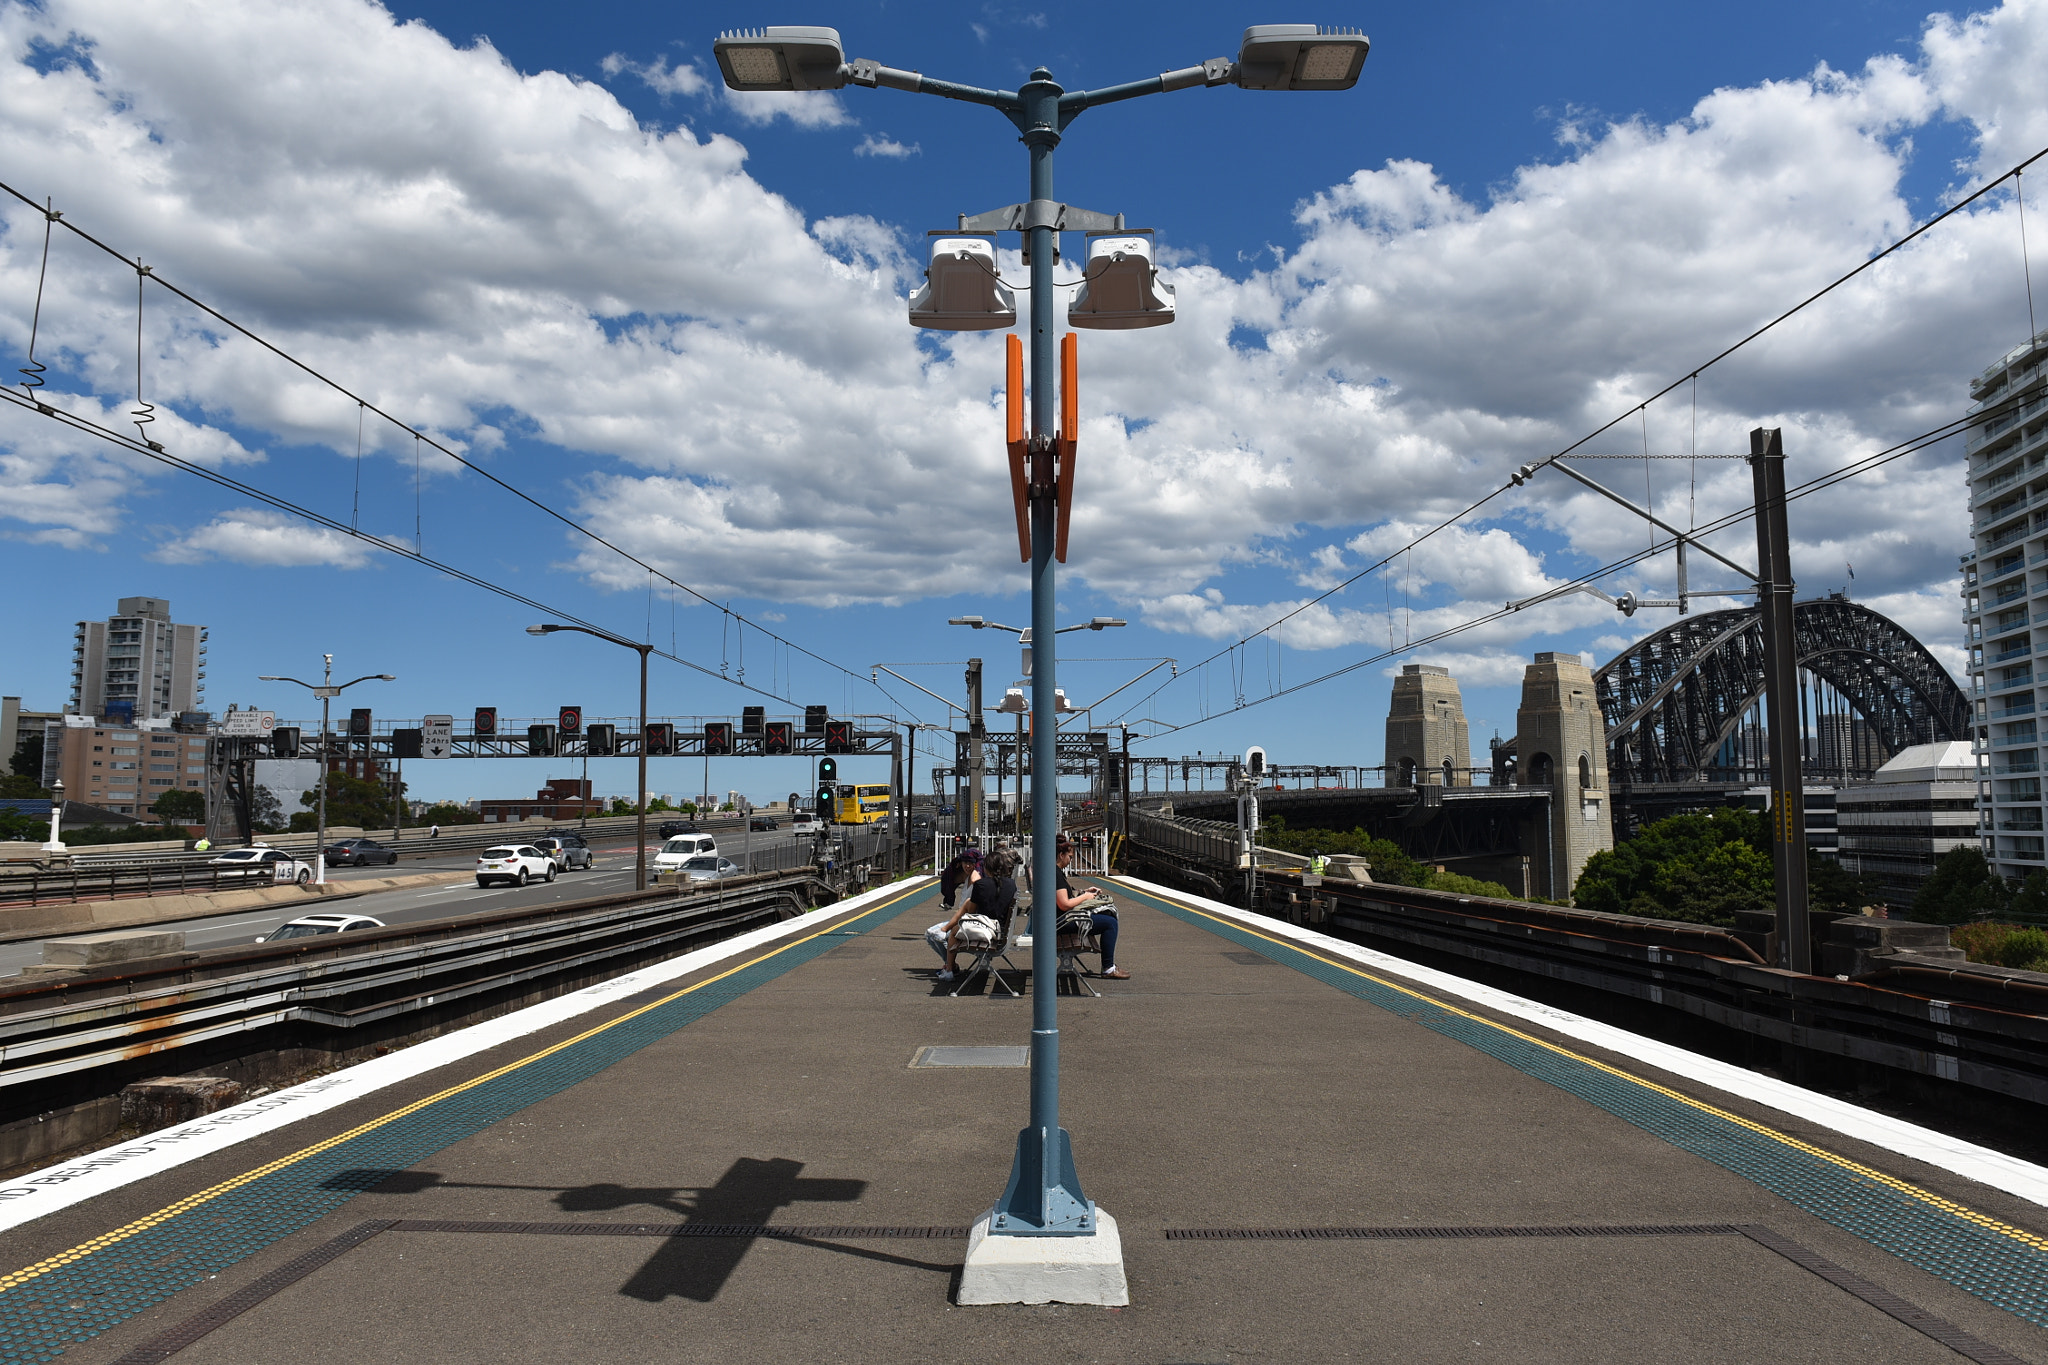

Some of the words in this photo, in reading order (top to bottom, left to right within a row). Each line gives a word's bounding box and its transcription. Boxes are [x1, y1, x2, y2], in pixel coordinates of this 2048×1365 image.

[425, 737, 450, 745] 24hrs
[656, 747, 663, 755] 4
[715, 747, 722, 755] 3
[776, 746, 782, 754] 2
[24, 1147, 157, 1185] BEHIND
[142, 1127, 217, 1144] THE
[198, 1094, 307, 1125] YELLOW
